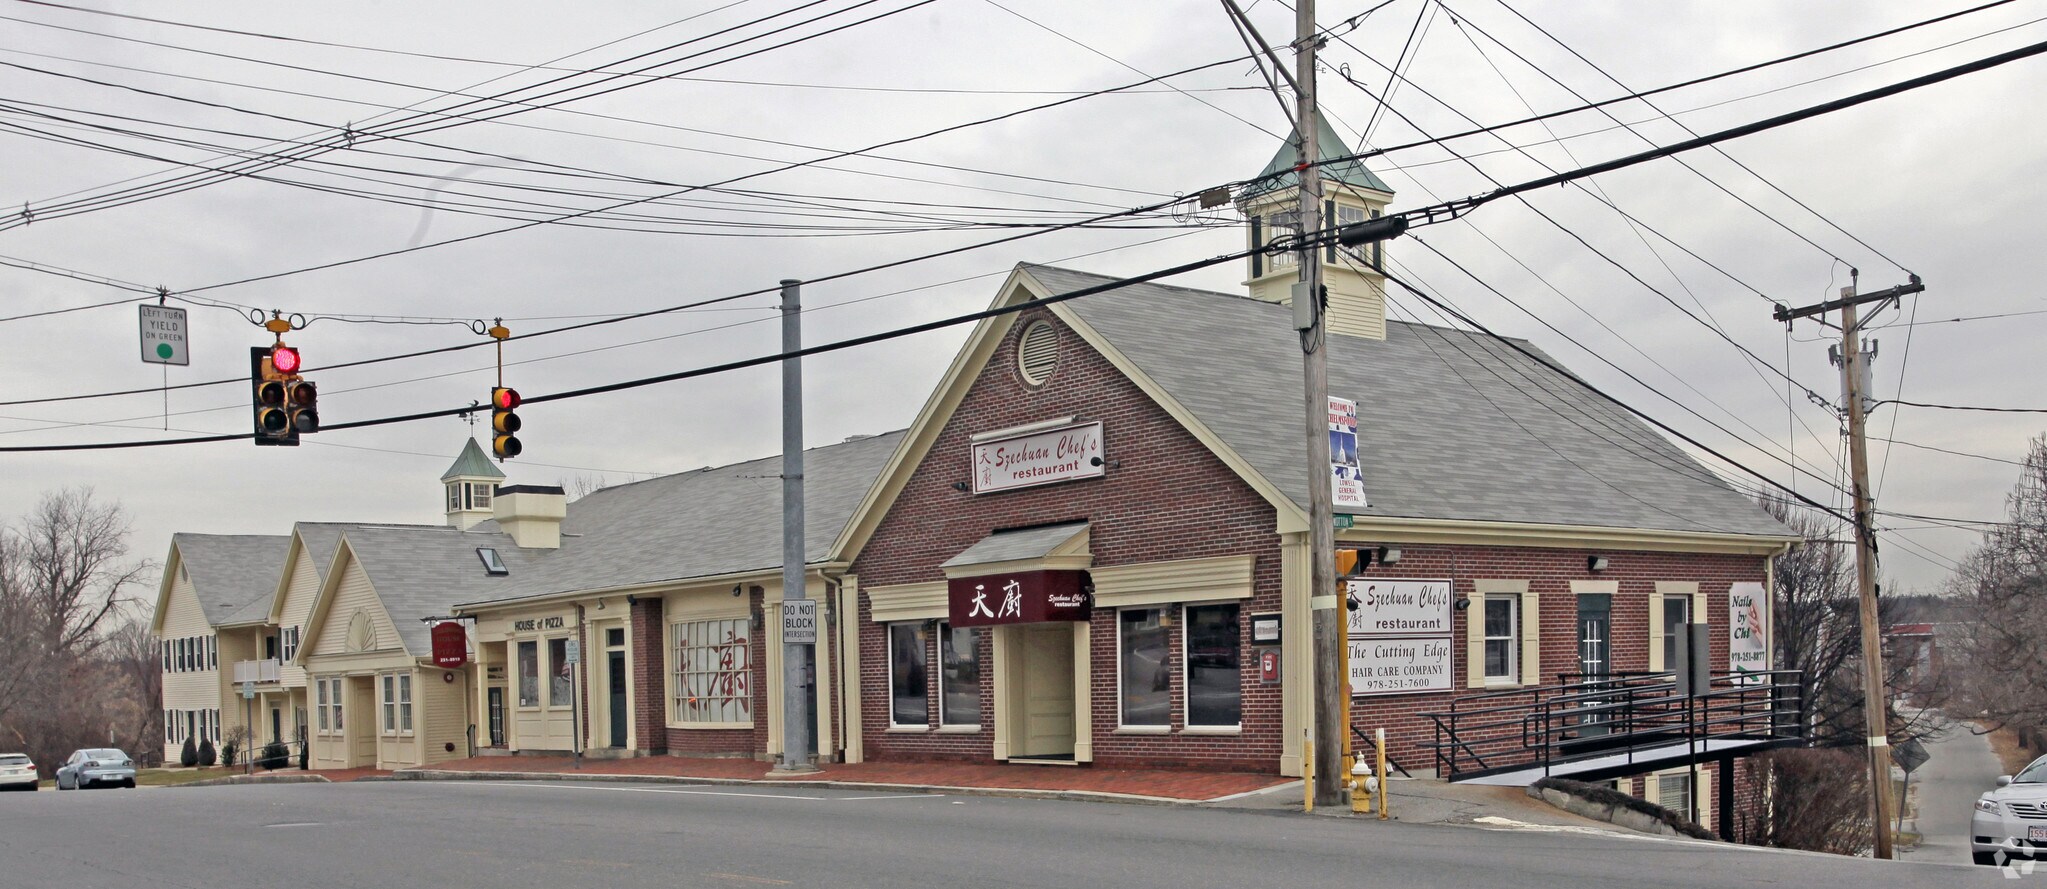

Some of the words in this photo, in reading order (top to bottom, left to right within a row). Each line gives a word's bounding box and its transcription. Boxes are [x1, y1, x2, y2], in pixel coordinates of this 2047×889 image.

[143, 309, 160, 318] LEFT
[164, 311, 183, 320] TURN
[150, 320, 178, 331] YIELD
[145, 331, 156, 339] ON
[159, 332, 182, 341] GREEN
[995, 442, 1050, 472] Szechuan
[1056, 433, 1098, 460] Chef's
[1013, 459, 1079, 479] restaurant
[1339, 479, 1355, 487] LOWELL
[1367, 585, 1413, 612] Szechuan
[1419, 585, 1447, 612] Chef's
[1732, 595, 1753, 608] Nails
[784, 604, 796, 616] DO
[799, 604, 814, 615] NOT
[514, 619, 535, 631] HOUSE
[536, 618, 543, 629] of
[545, 616, 564, 628] PIZZA
[785, 618, 813, 628] BLOCK
[1376, 618, 1441, 629] restaurant
[1737, 611, 1747, 625] by
[784, 630, 815, 638] INTERSECTION
[1348, 642, 1366, 659] The
[1374, 644, 1415, 664] Cutting
[1423, 641, 1448, 663] Edge
[1352, 667, 1373, 677] HAIR
[1377, 666, 1400, 677] CARE
[1403, 665, 1444, 676] COMPANY
[1367, 678, 1430, 689] 978-251-7600
